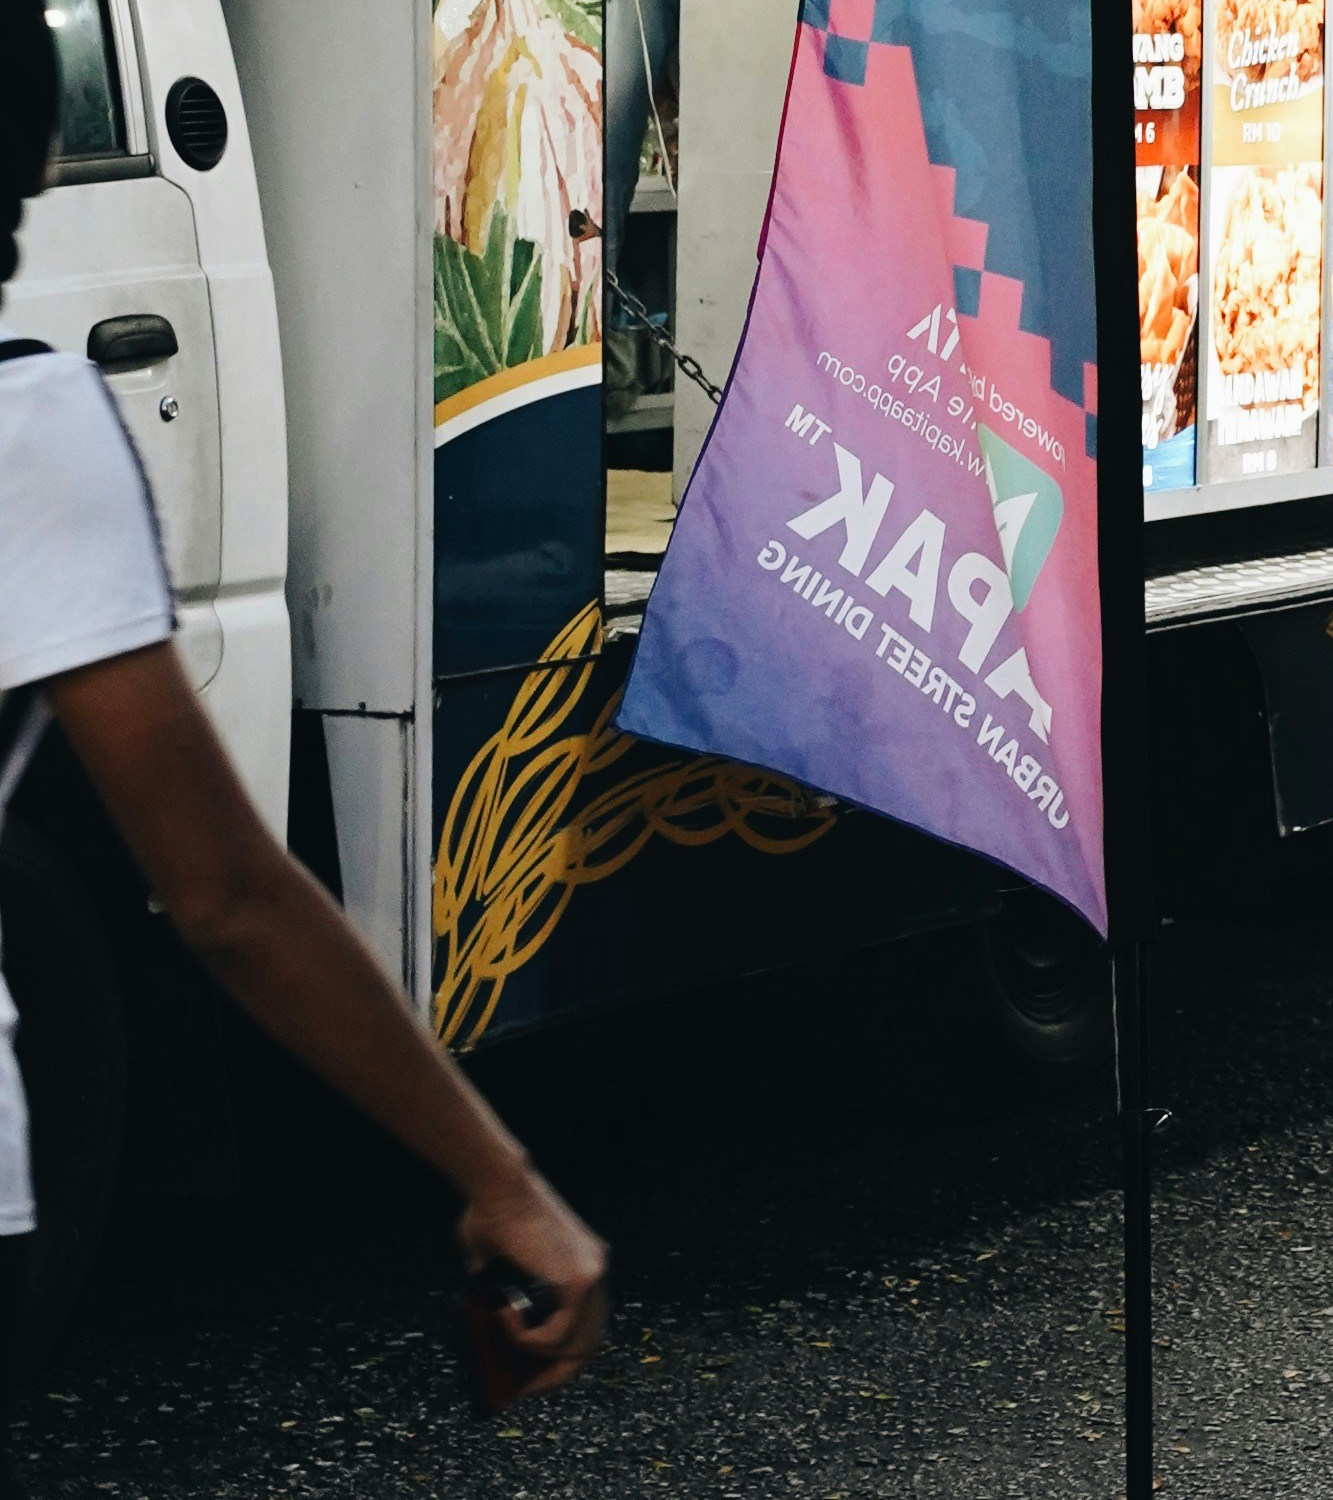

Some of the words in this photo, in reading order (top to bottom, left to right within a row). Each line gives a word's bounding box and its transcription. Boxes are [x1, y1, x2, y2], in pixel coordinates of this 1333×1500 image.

[1228, 19, 1300, 70] Chicken
[1230, 62, 1300, 112] Crunch
[1145, 121, 1156, 144] 6
[1242, 122, 1263, 143] RM
